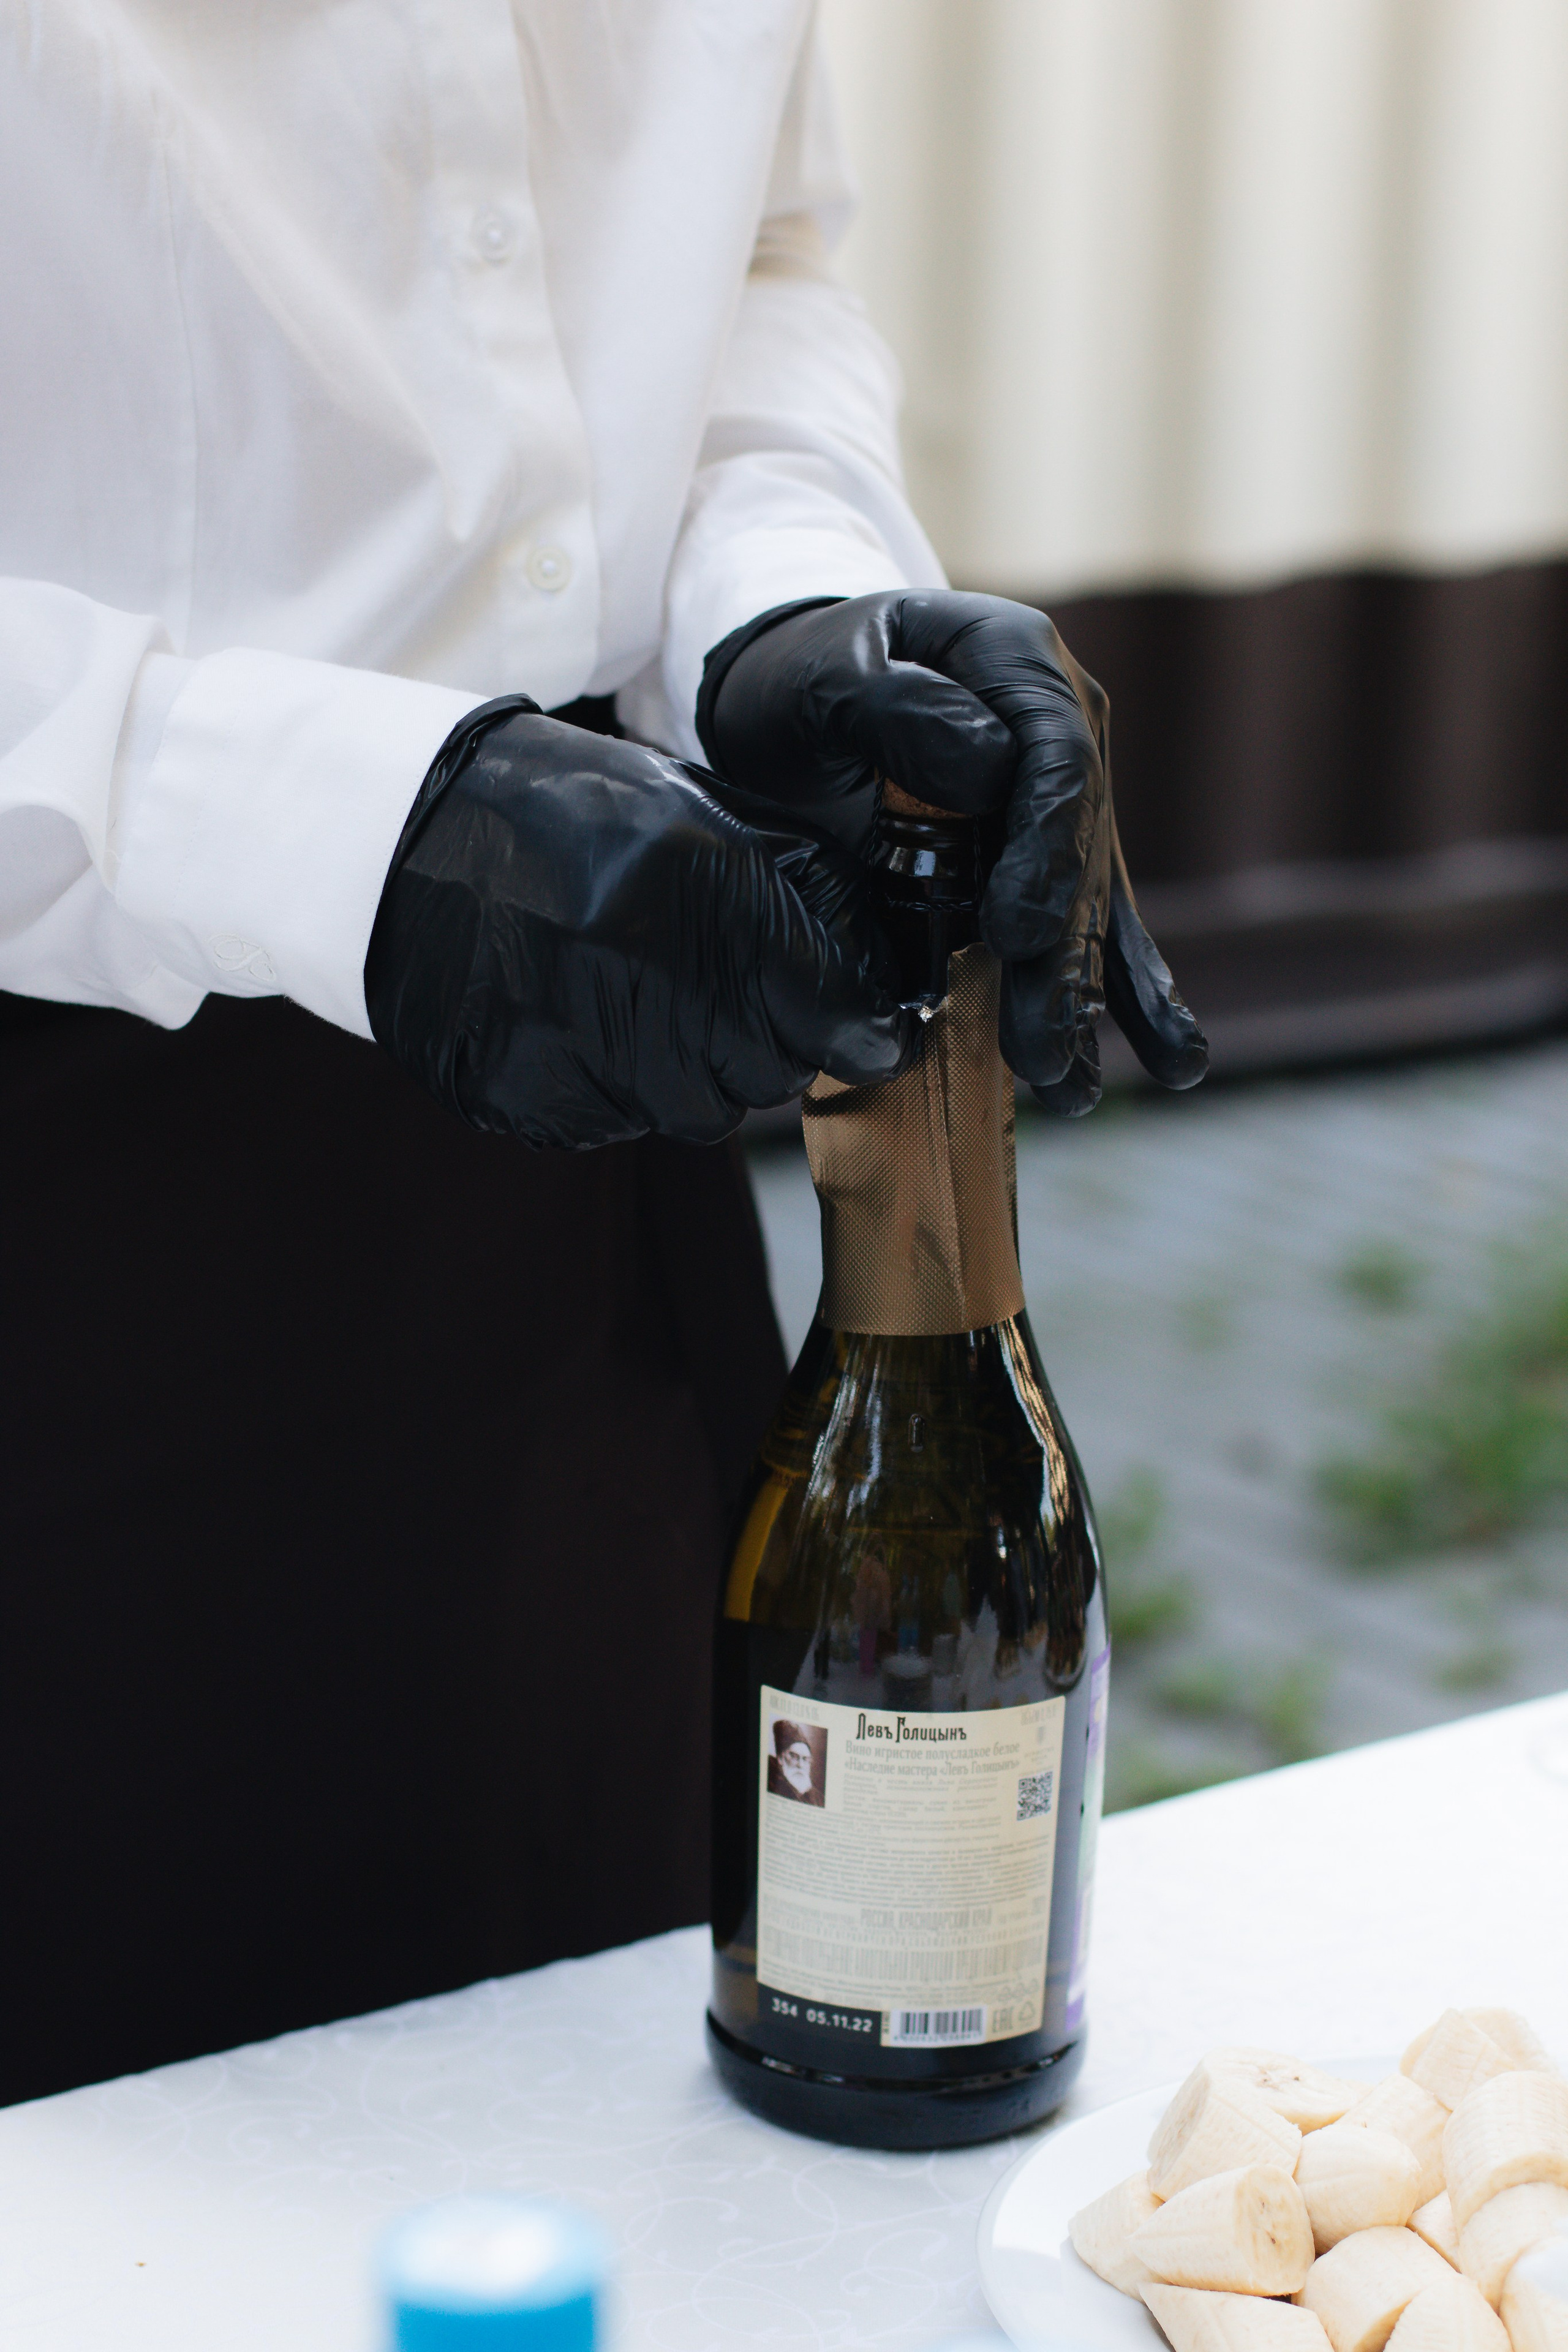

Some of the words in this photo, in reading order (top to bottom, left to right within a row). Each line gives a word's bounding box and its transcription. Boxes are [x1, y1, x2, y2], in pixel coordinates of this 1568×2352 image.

[855, 1713, 893, 1740] Левъ
[895, 1716, 967, 1743] Голицынъ
[845, 1740, 872, 1757] Вино
[874, 1747, 922, 1762] игристое
[925, 1746, 991, 1762] полусладкое
[993, 1741, 1020, 1756] белое
[897, 1765, 938, 1779] мастера
[772, 1996, 798, 2018] 354
[805, 2007, 873, 2033] 05.11.22
